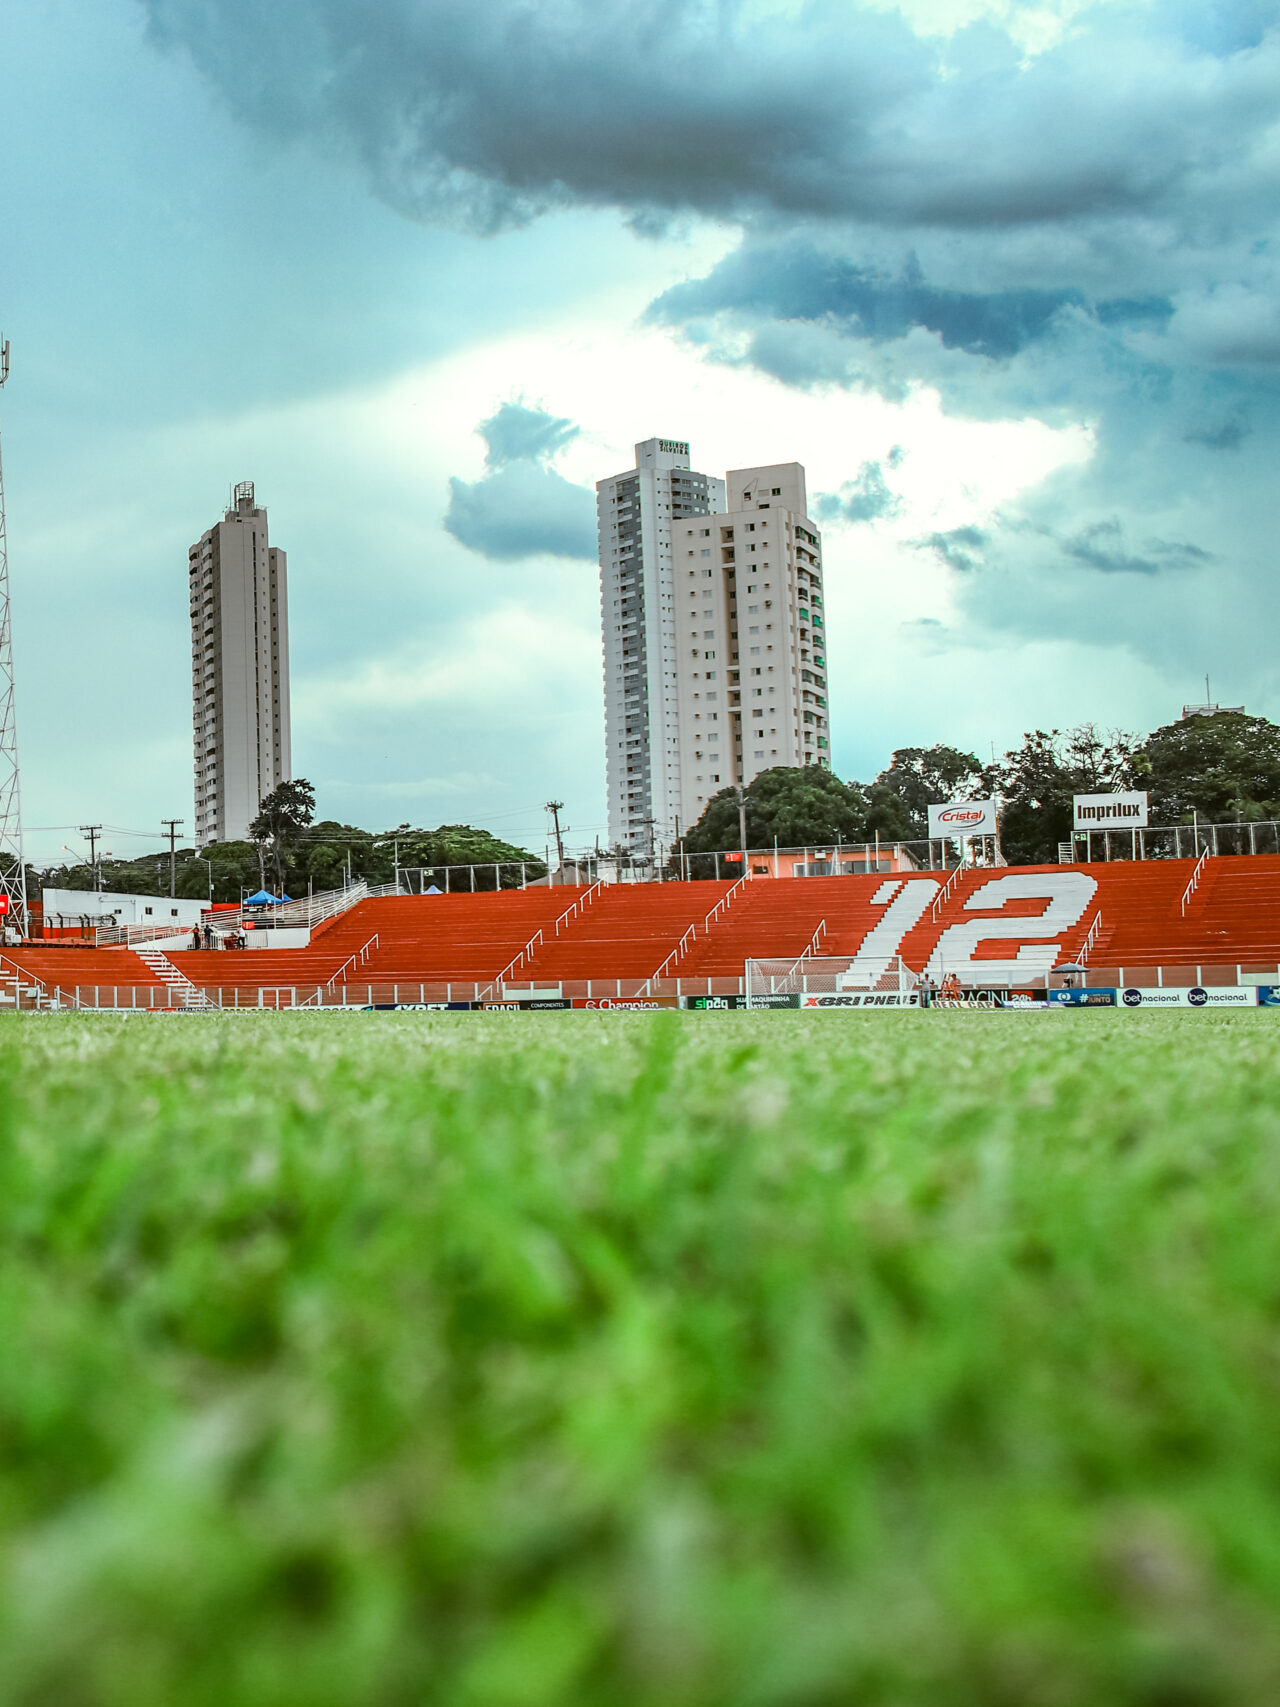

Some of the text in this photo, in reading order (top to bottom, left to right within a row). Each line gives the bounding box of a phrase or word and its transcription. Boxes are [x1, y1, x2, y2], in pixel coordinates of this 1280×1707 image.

[659, 440, 688, 450] QUEIROZ
[660, 446, 688, 455] SILVEIRA
[942, 810, 982, 822] Cristal
[1077, 802, 1140, 821] Imprilux
[838, 871, 1098, 987] 12
[598, 999, 659, 1010] Champion
[803, 995, 918, 1006] XBRI PNEUS
[932, 1001, 993, 1009] REAL CAP
